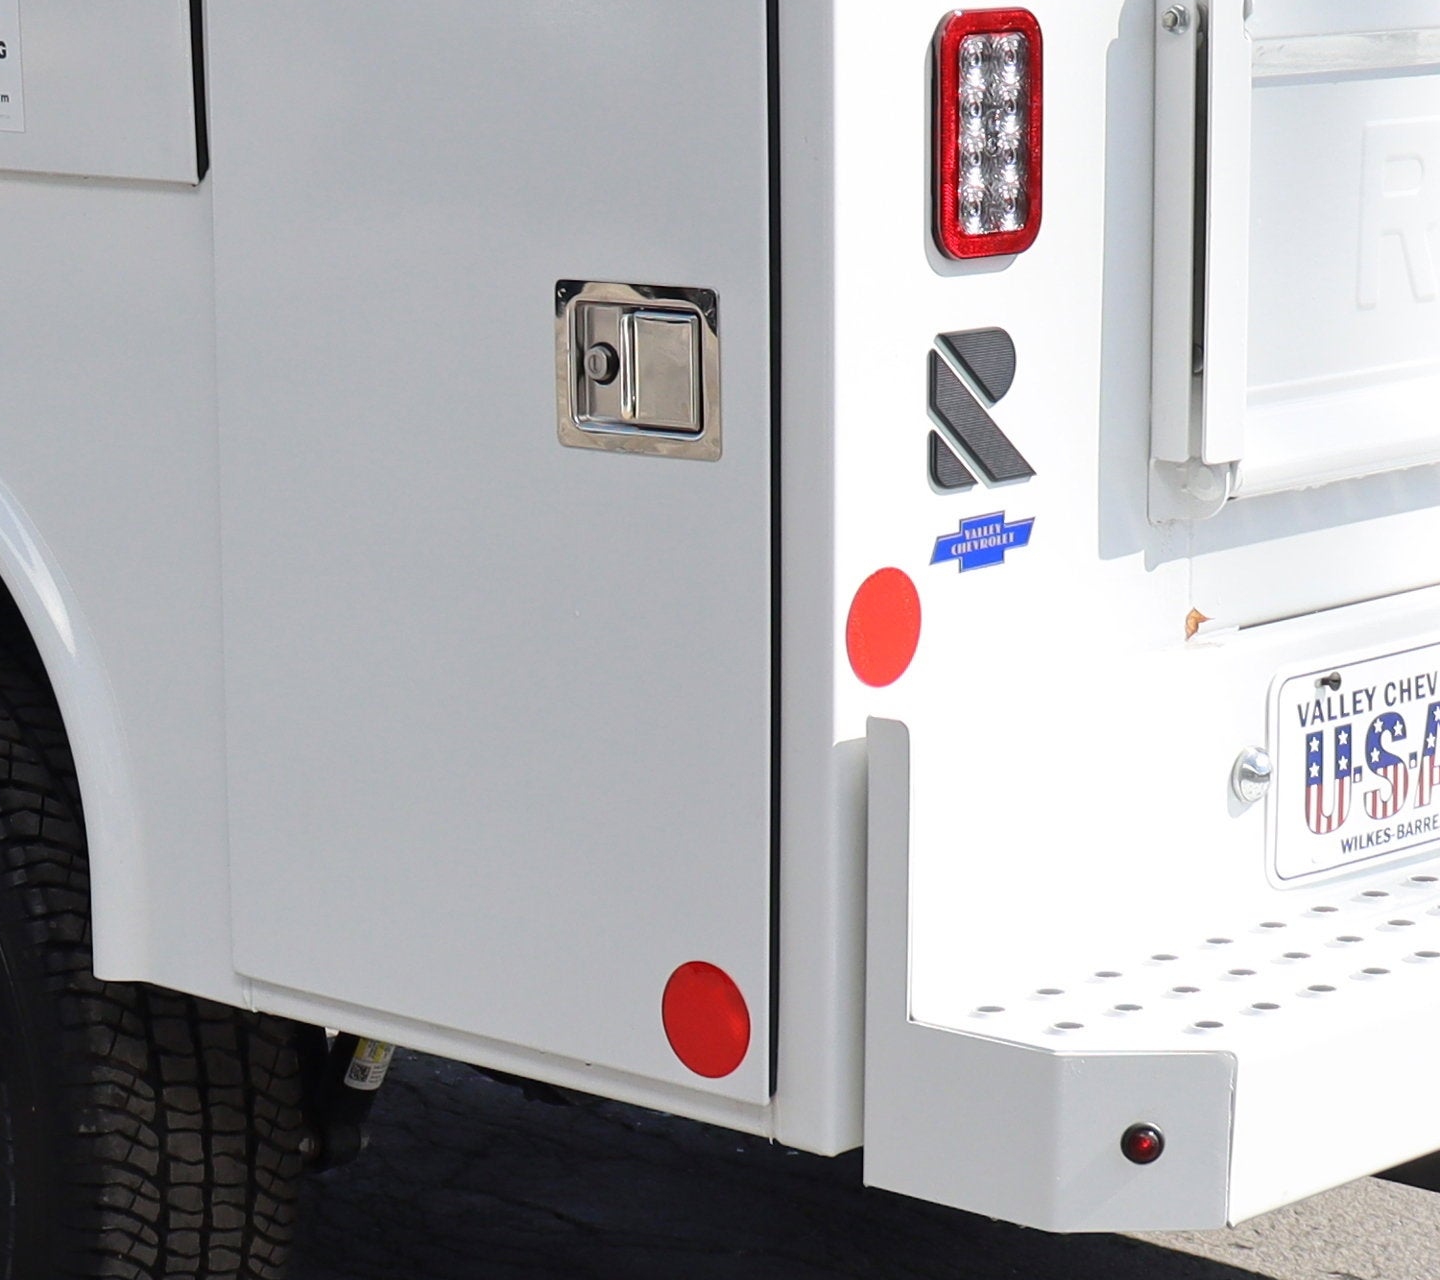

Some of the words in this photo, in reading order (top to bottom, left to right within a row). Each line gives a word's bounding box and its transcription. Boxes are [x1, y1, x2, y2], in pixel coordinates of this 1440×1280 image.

[964, 523, 1002, 540] VALLEY
[951, 532, 1016, 556] CHEVROLET
[1297, 686, 1376, 728] VALLEY
